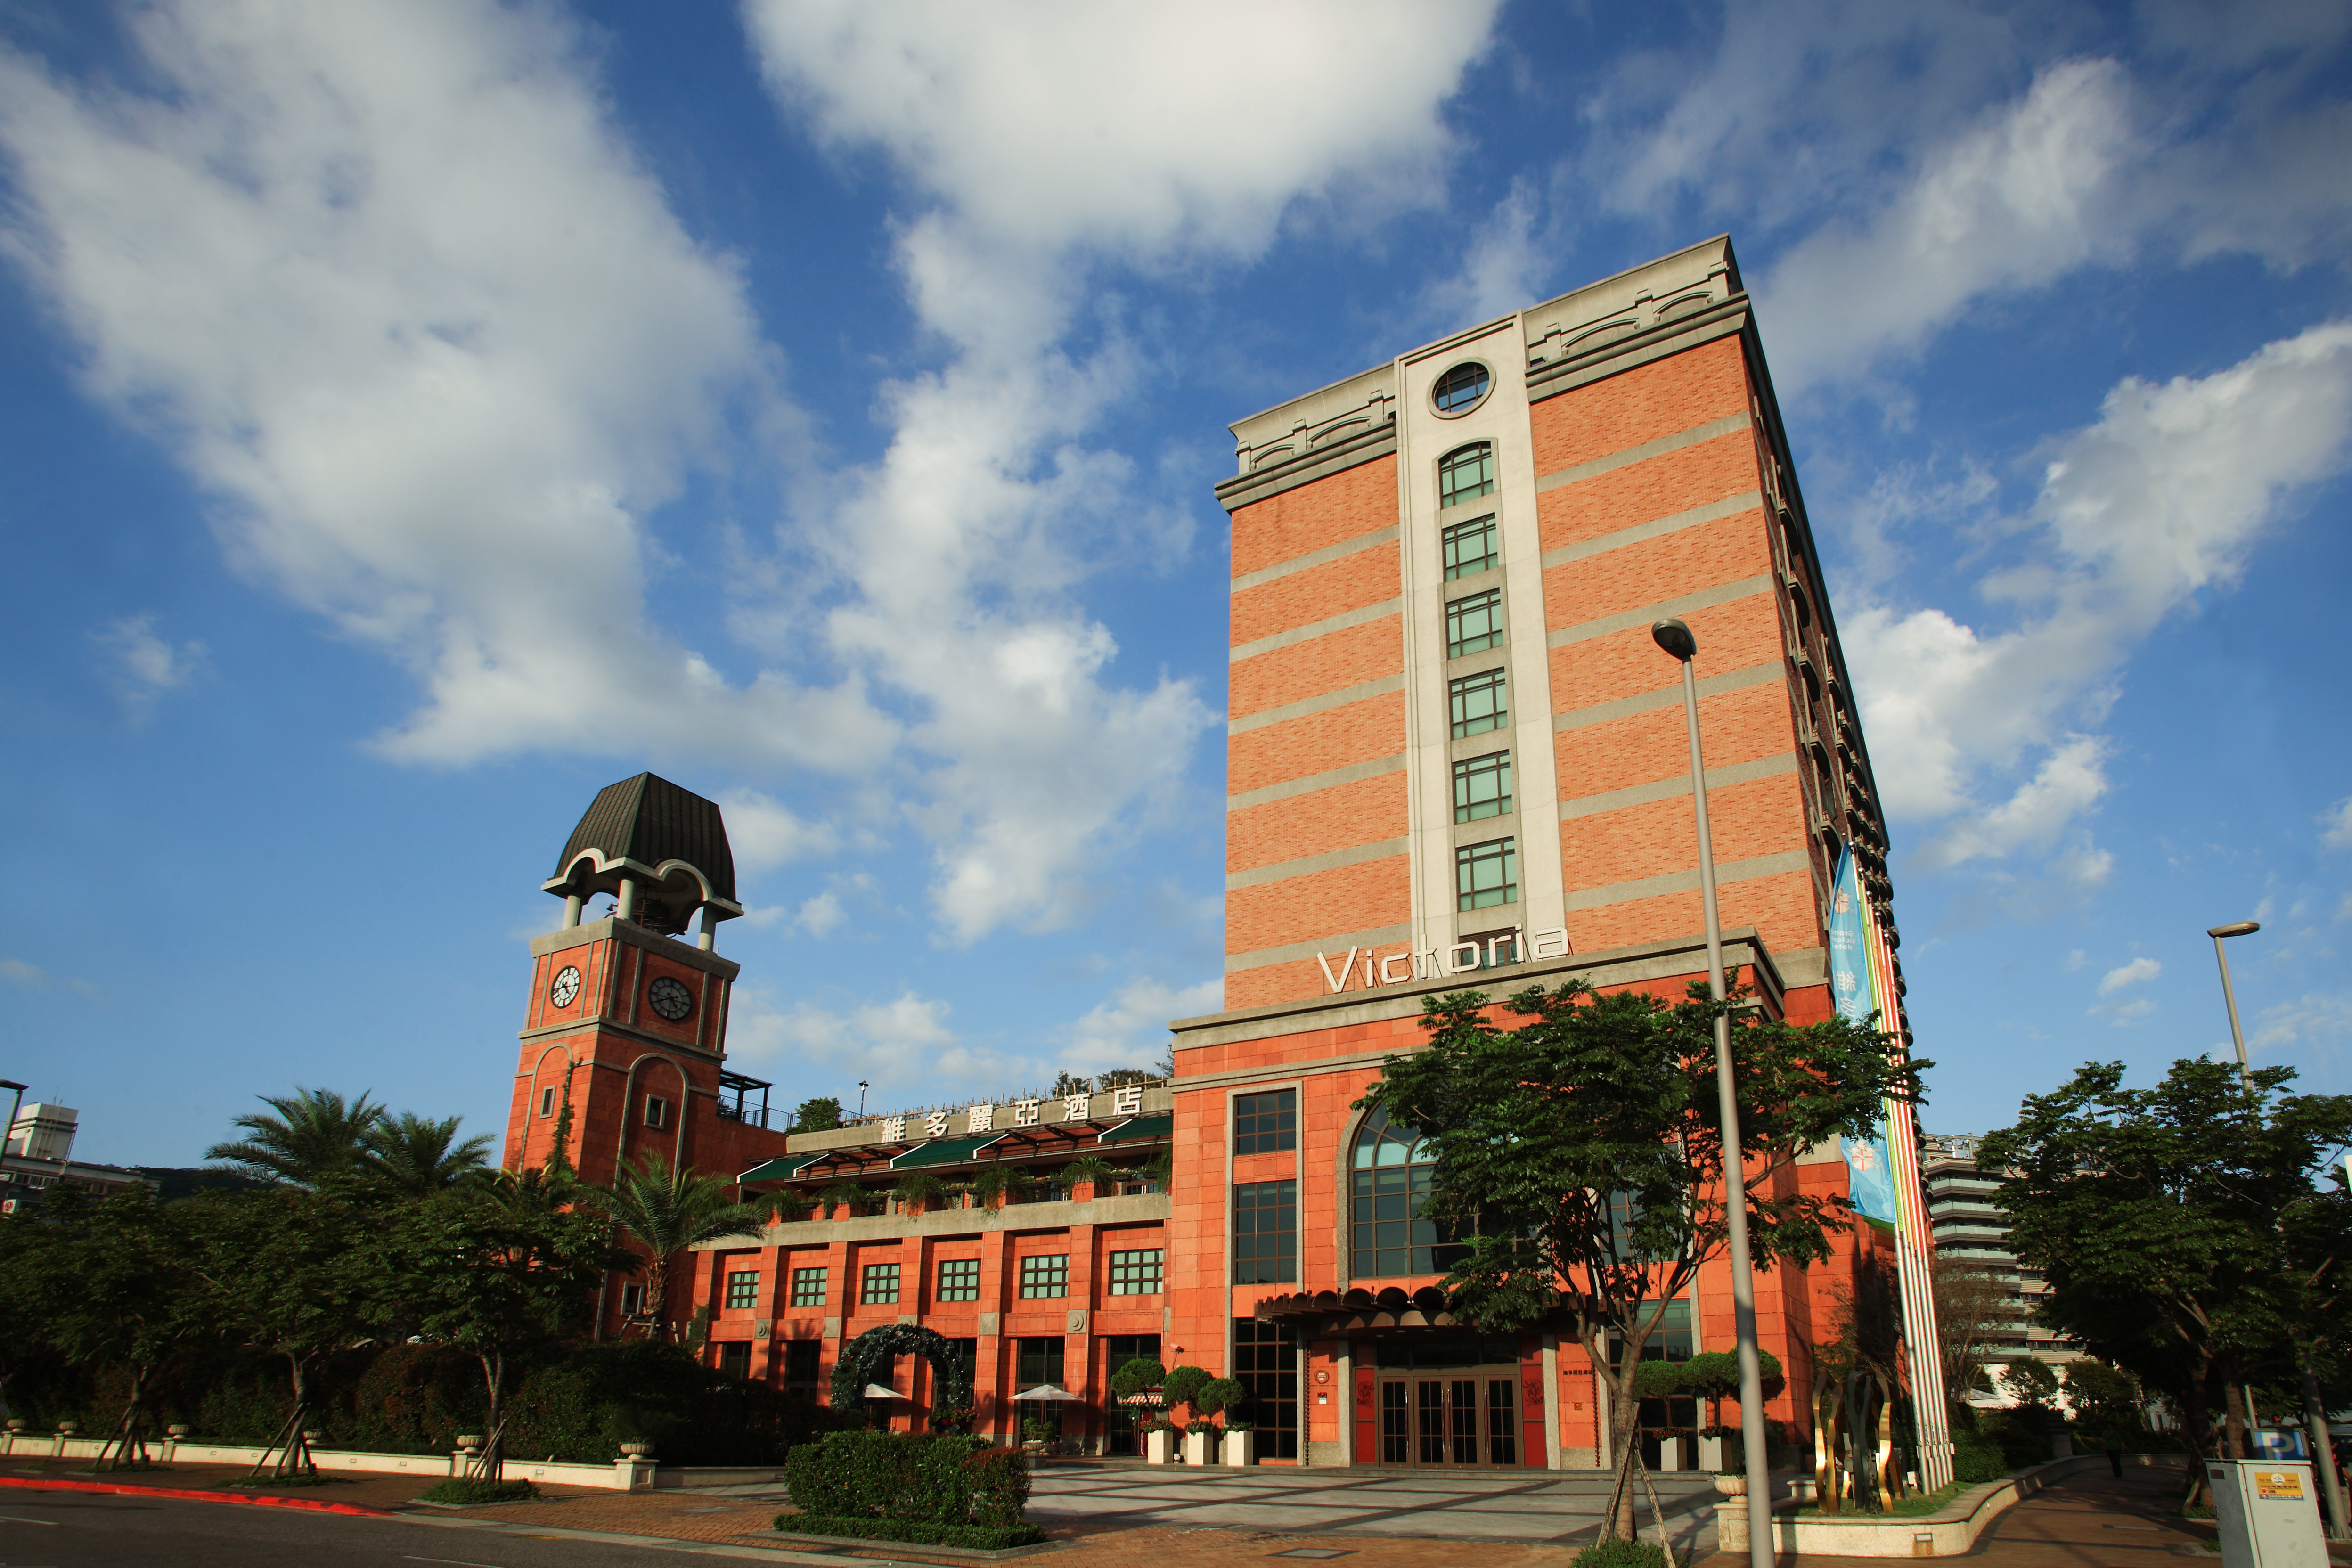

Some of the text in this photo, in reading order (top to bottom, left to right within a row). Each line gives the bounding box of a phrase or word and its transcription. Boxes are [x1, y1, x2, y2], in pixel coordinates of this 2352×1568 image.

[1317, 923, 1569, 994] Victoria
[882, 1086, 1142, 1143] 維多麗亞酒店
[2261, 1432, 2295, 1460] P
